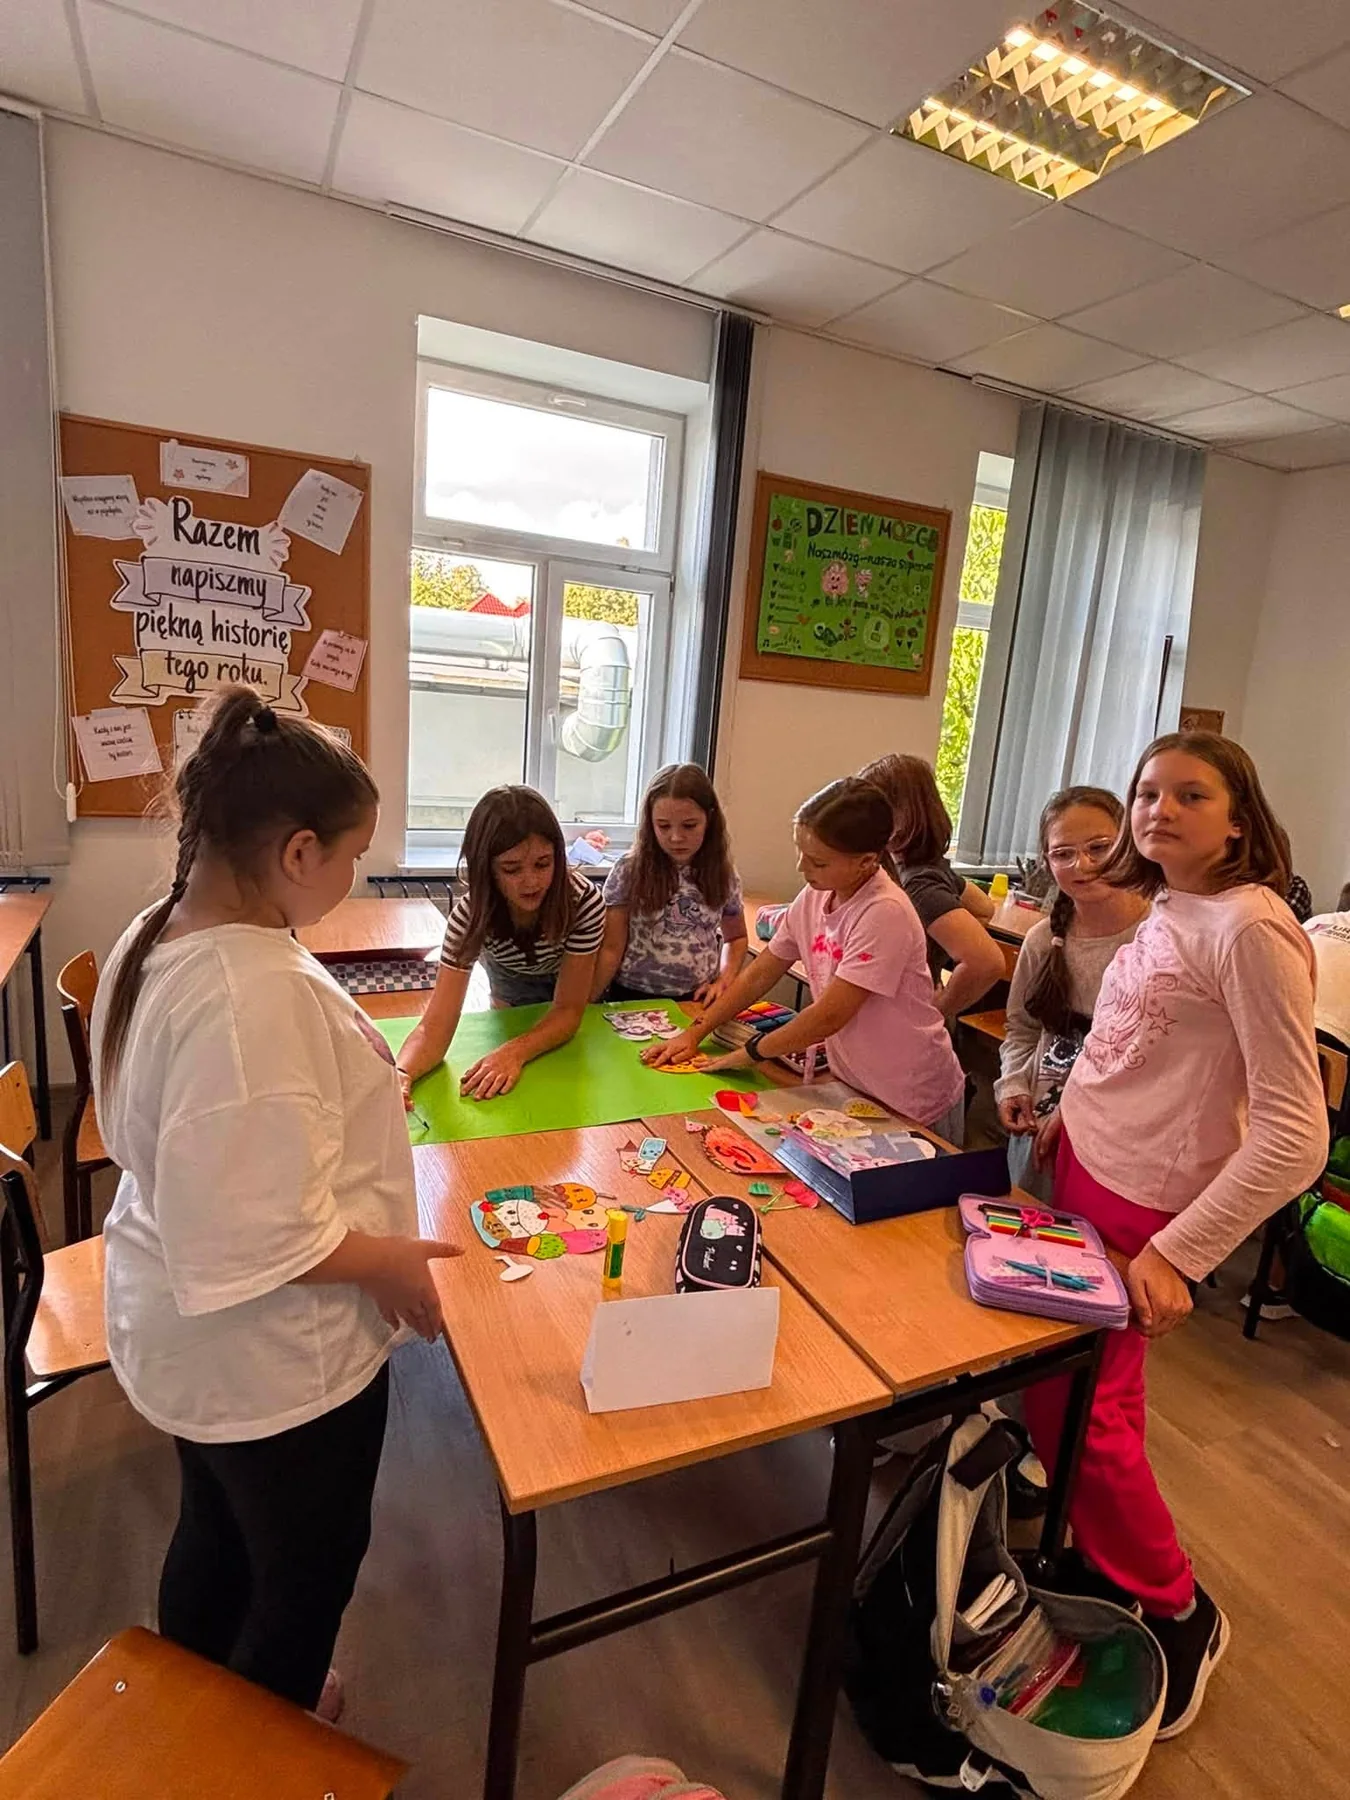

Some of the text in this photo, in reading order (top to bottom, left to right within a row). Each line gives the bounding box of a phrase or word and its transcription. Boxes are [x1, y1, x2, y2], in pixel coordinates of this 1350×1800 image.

[172, 497, 260, 555] Razem
[171, 565, 267, 605] napiszmy
[136, 602, 288, 655] piękną historię
[165, 651, 209, 693] tego
[217, 653, 267, 685] roku.
